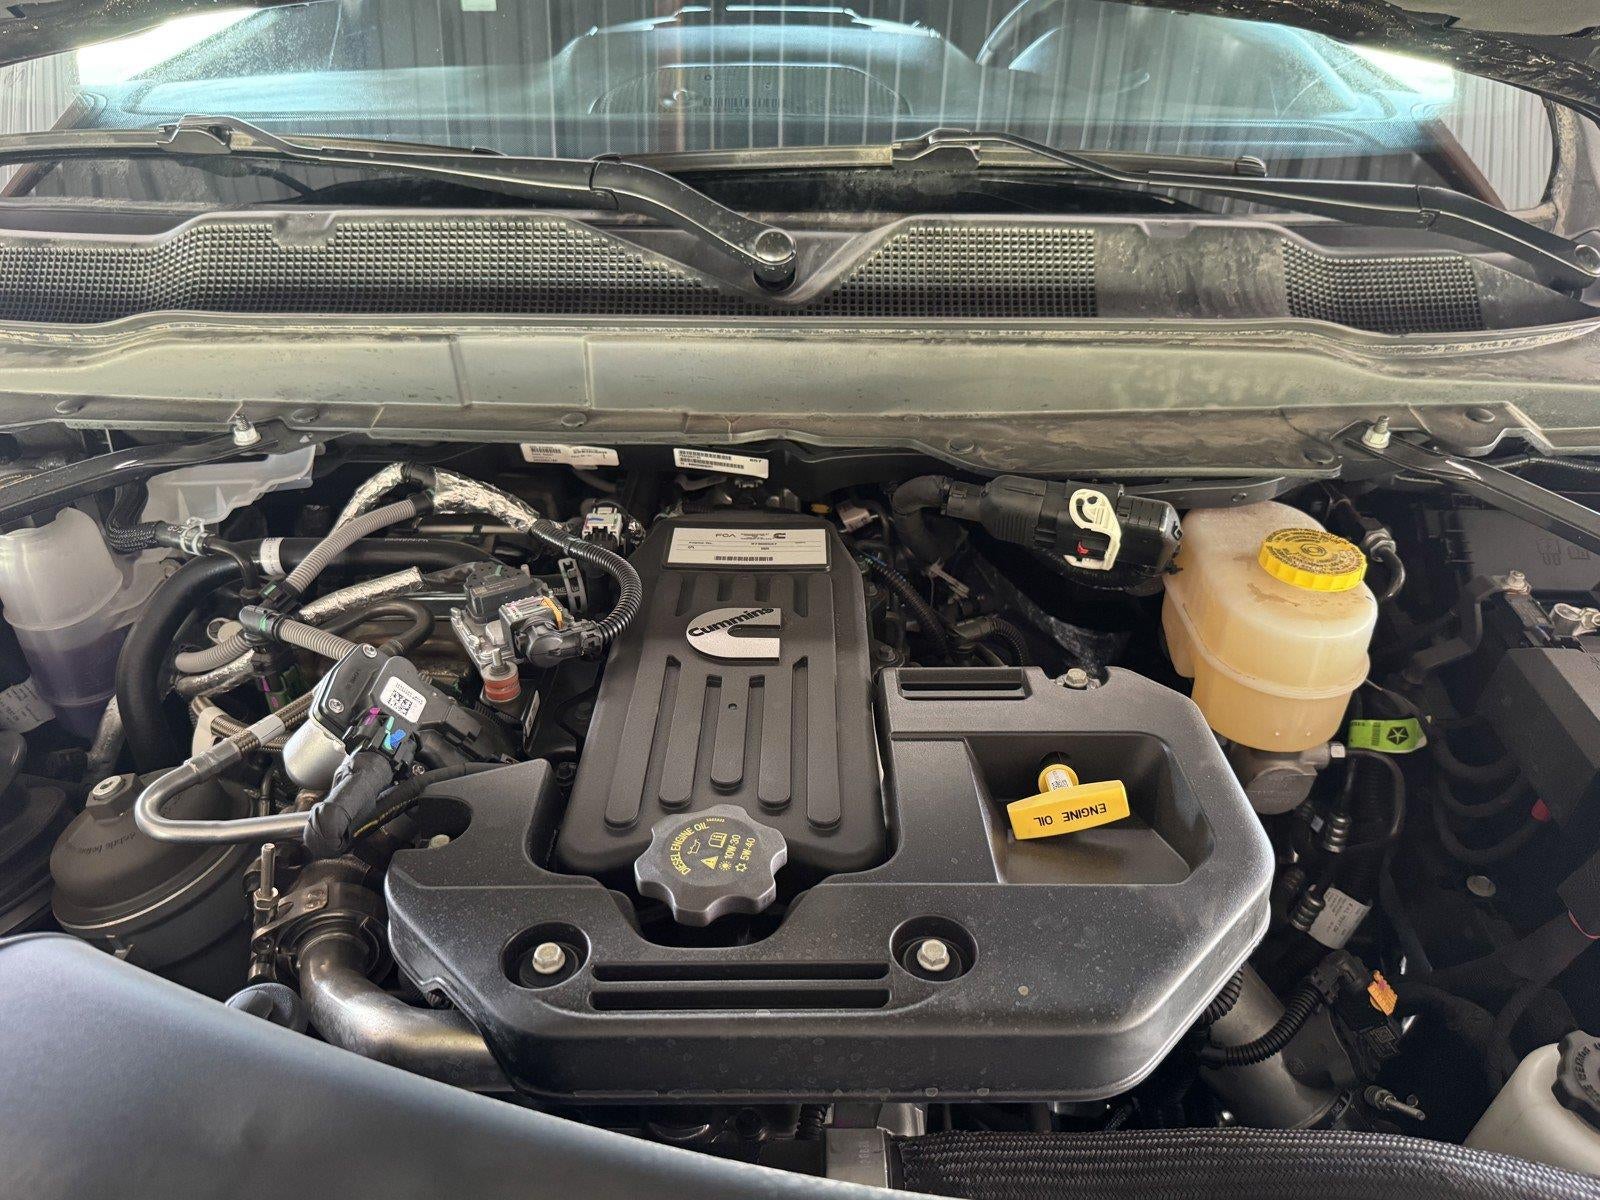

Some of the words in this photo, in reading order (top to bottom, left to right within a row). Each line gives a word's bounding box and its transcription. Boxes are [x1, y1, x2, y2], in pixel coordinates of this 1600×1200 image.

[688, 608, 774, 637] Cummins
[1033, 815, 1054, 827] OIL
[1061, 803, 1107, 822] ENGINE
[693, 822, 710, 832] OIL
[670, 827, 695, 852] ENGINE
[724, 834, 741, 860] 10W-30
[740, 837, 756, 861] 5W-40
[670, 851, 691, 876] DIESEL
